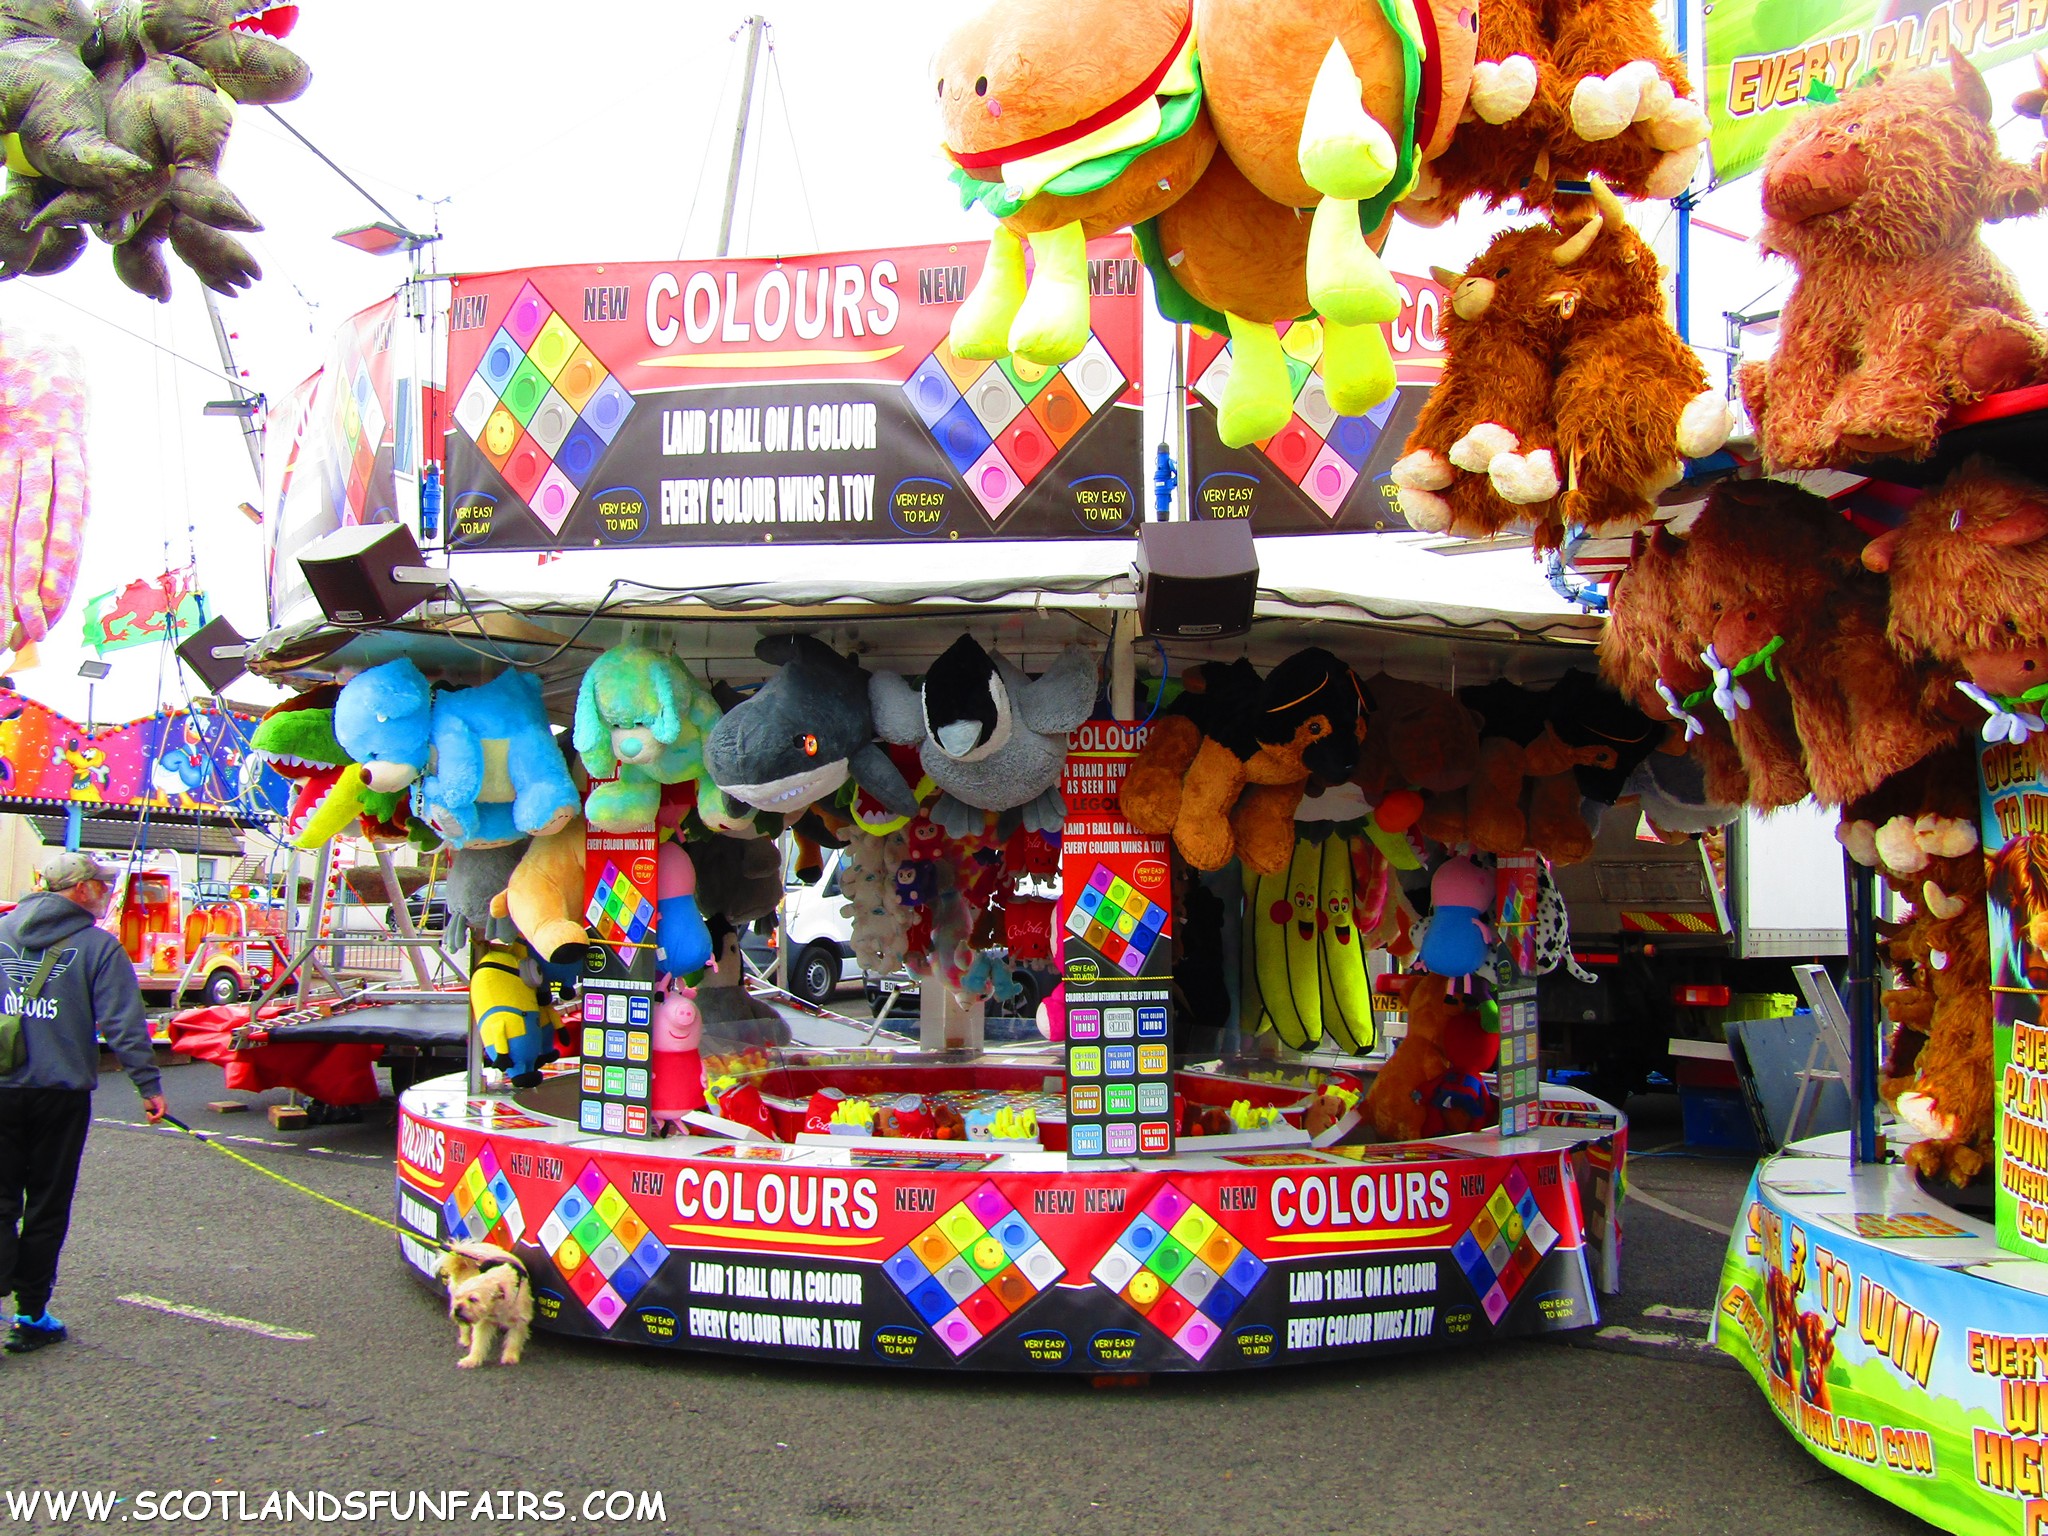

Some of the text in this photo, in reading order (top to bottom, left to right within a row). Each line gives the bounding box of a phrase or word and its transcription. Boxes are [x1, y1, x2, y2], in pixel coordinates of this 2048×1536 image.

[1727, 35, 1859, 117] EVERY
[1088, 258, 1139, 297] NEW
[918, 265, 967, 305] NEW
[583, 285, 630, 322] NEW
[645, 260, 900, 347] COLOURS
[451, 294, 489, 331] NEW
[662, 402, 877, 456] LAND 1 BALL ON A COLOUR
[660, 473, 876, 525] EVERY COLOUR WINS A TOY
[896, 493, 944, 507] VERY EASY
[1076, 490, 1126, 504] VERY EASY
[1204, 488, 1254, 502] VERY EASY
[455, 505, 493, 520] VERY EASY
[599, 501, 642, 515] VERY EASY
[1211, 505, 1250, 518] TO PLAY
[1389, 501, 1402, 512] TO
[904, 510, 941, 523] TO PLAY
[1084, 508, 1122, 520] TO WIN
[460, 520, 490, 534] TO PLAY
[606, 518, 638, 531] TO WIN
[1067, 726, 1156, 751] COLOUR
[1064, 764, 1070, 777] A
[1073, 764, 1104, 777] BRAND
[1107, 763, 1126, 777] NEW
[1067, 780, 1117, 794] AS SEEN IN
[1993, 796, 2020, 842] TO
[1064, 823, 1085, 835] LAND
[1092, 822, 1112, 835] BALL
[1113, 822, 1124, 834] ON
[1064, 840, 1165, 854] EVERY COLOUR WINS A TOY
[1373, 996, 1403, 1010] YN5
[1076, 1023, 1095, 1032] JUMBO
[1143, 1021, 1162, 1030] JUMBO
[1076, 1062, 1096, 1070] SMALL
[1110, 1060, 1130, 1069] JUMBO
[1143, 1059, 1162, 1068] SMALL
[1076, 1100, 1096, 1109] JUMBO
[1111, 1098, 1130, 1108] SMALL
[1143, 1098, 1162, 1106] JUMBO
[1078, 1140, 1097, 1149] SMALL
[1112, 1139, 1131, 1147] JUMBO
[1145, 1137, 1164, 1147] SMALL
[510, 1152, 533, 1178] NEW
[536, 1156, 563, 1182] NEW
[1537, 1165, 1557, 1187] NEW
[631, 1167, 936, 1230] NEW COLOURS NEW
[1034, 1190, 1076, 1214] NEW
[1084, 1188, 1126, 1214] NEW
[1219, 1170, 1485, 1228] NEW COLOURS NEW
[689, 1262, 862, 1305] LAND 1 BALL ON A COLOUR
[1289, 1262, 1437, 1303] LAND 1 BALL ON A COLOUR
[1539, 1298, 1574, 1310] VERY EASY
[642, 1314, 675, 1326] VERY EASY
[1546, 1310, 1556, 1319] TO
[1815, 1247, 1851, 1327] TO
[1858, 1276, 1940, 1388] WIN
[647, 1325, 657, 1333] TO
[689, 1307, 861, 1351] EVERY COLOUR WINS A TOY
[1287, 1306, 1435, 1349] EVERY COLOUR WINS A TOY
[877, 1335, 917, 1345] VERY EASY
[1024, 1339, 1065, 1349] VERY EASY
[1094, 1338, 1135, 1348] VERY EASY
[1237, 1334, 1273, 1345] VERY EASY
[884, 1345, 914, 1355] TO PLAY
[1031, 1350, 1062, 1359] TO WIN
[1101, 1349, 1132, 1359] TO PLAY
[1243, 1345, 1270, 1355] TO WIN
[1881, 1426, 1935, 1477] COW
